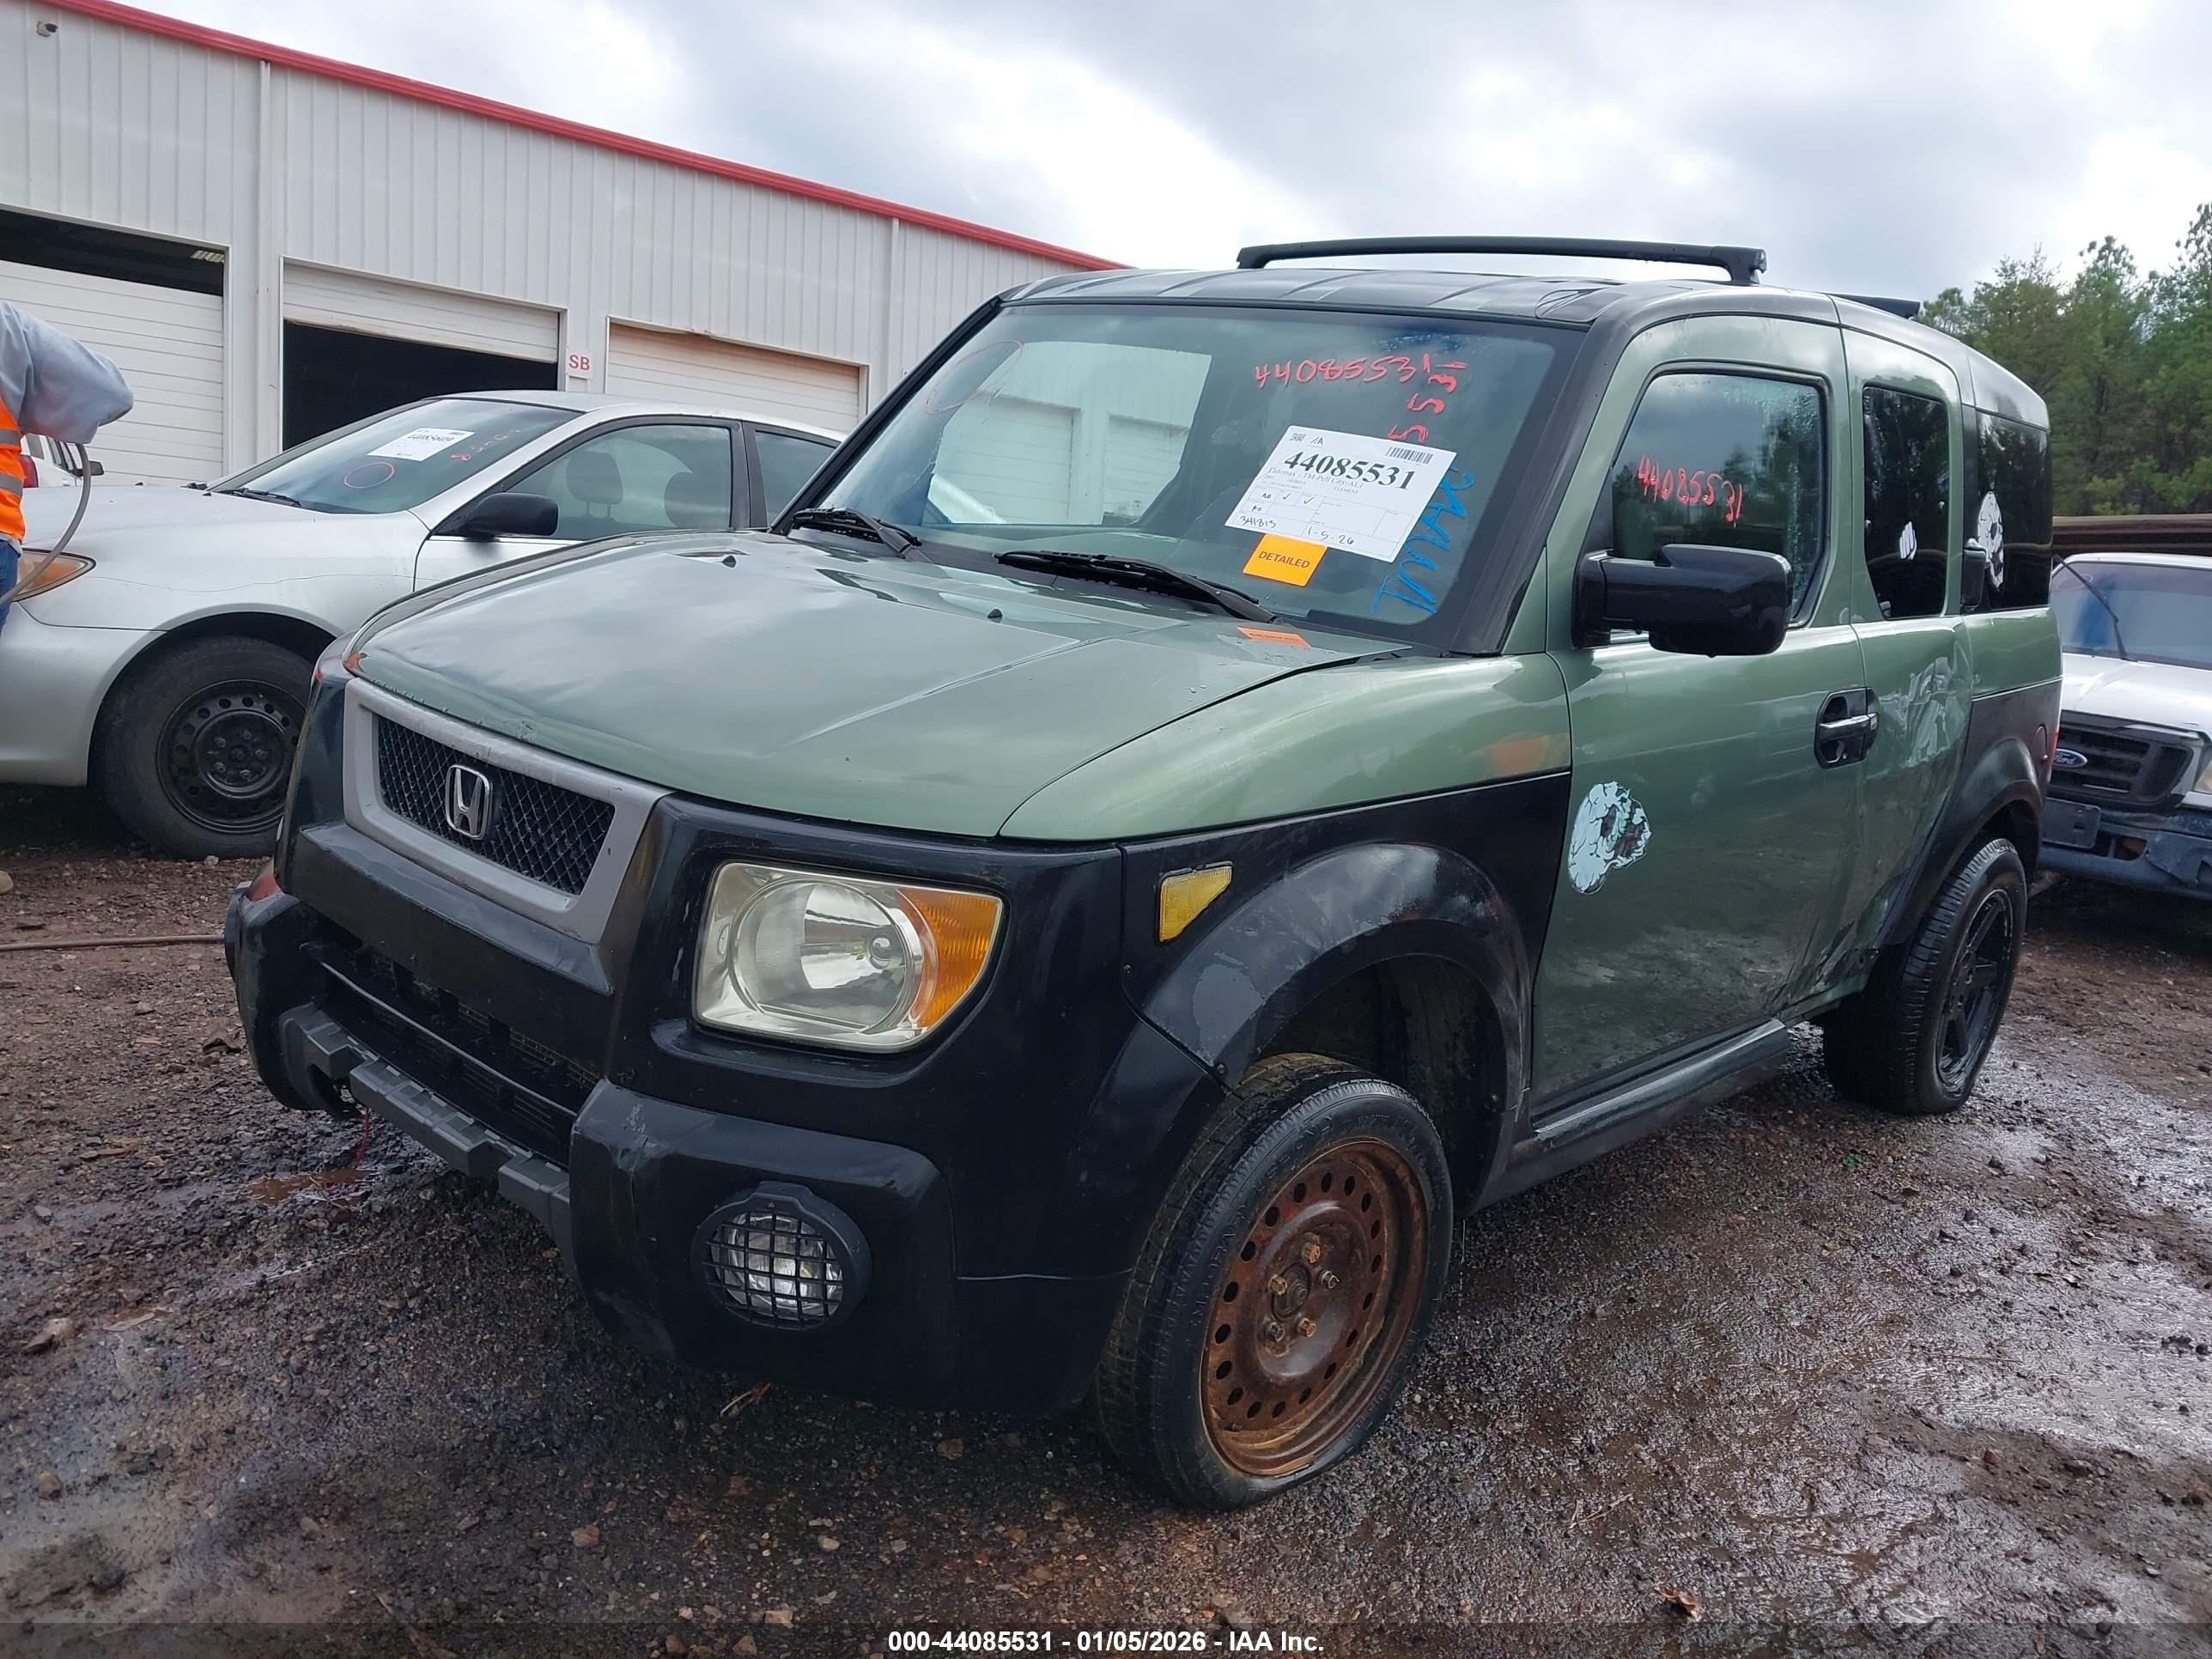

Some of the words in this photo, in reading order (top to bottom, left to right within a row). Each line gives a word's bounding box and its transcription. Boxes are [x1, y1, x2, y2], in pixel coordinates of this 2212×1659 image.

[568, 354, 591, 371] SB
[1255, 353, 1431, 388] 44085531
[1284, 451, 1416, 490] 44085531
[1635, 454, 1743, 523] 44085531
[1258, 550, 1310, 568] DETAILED
